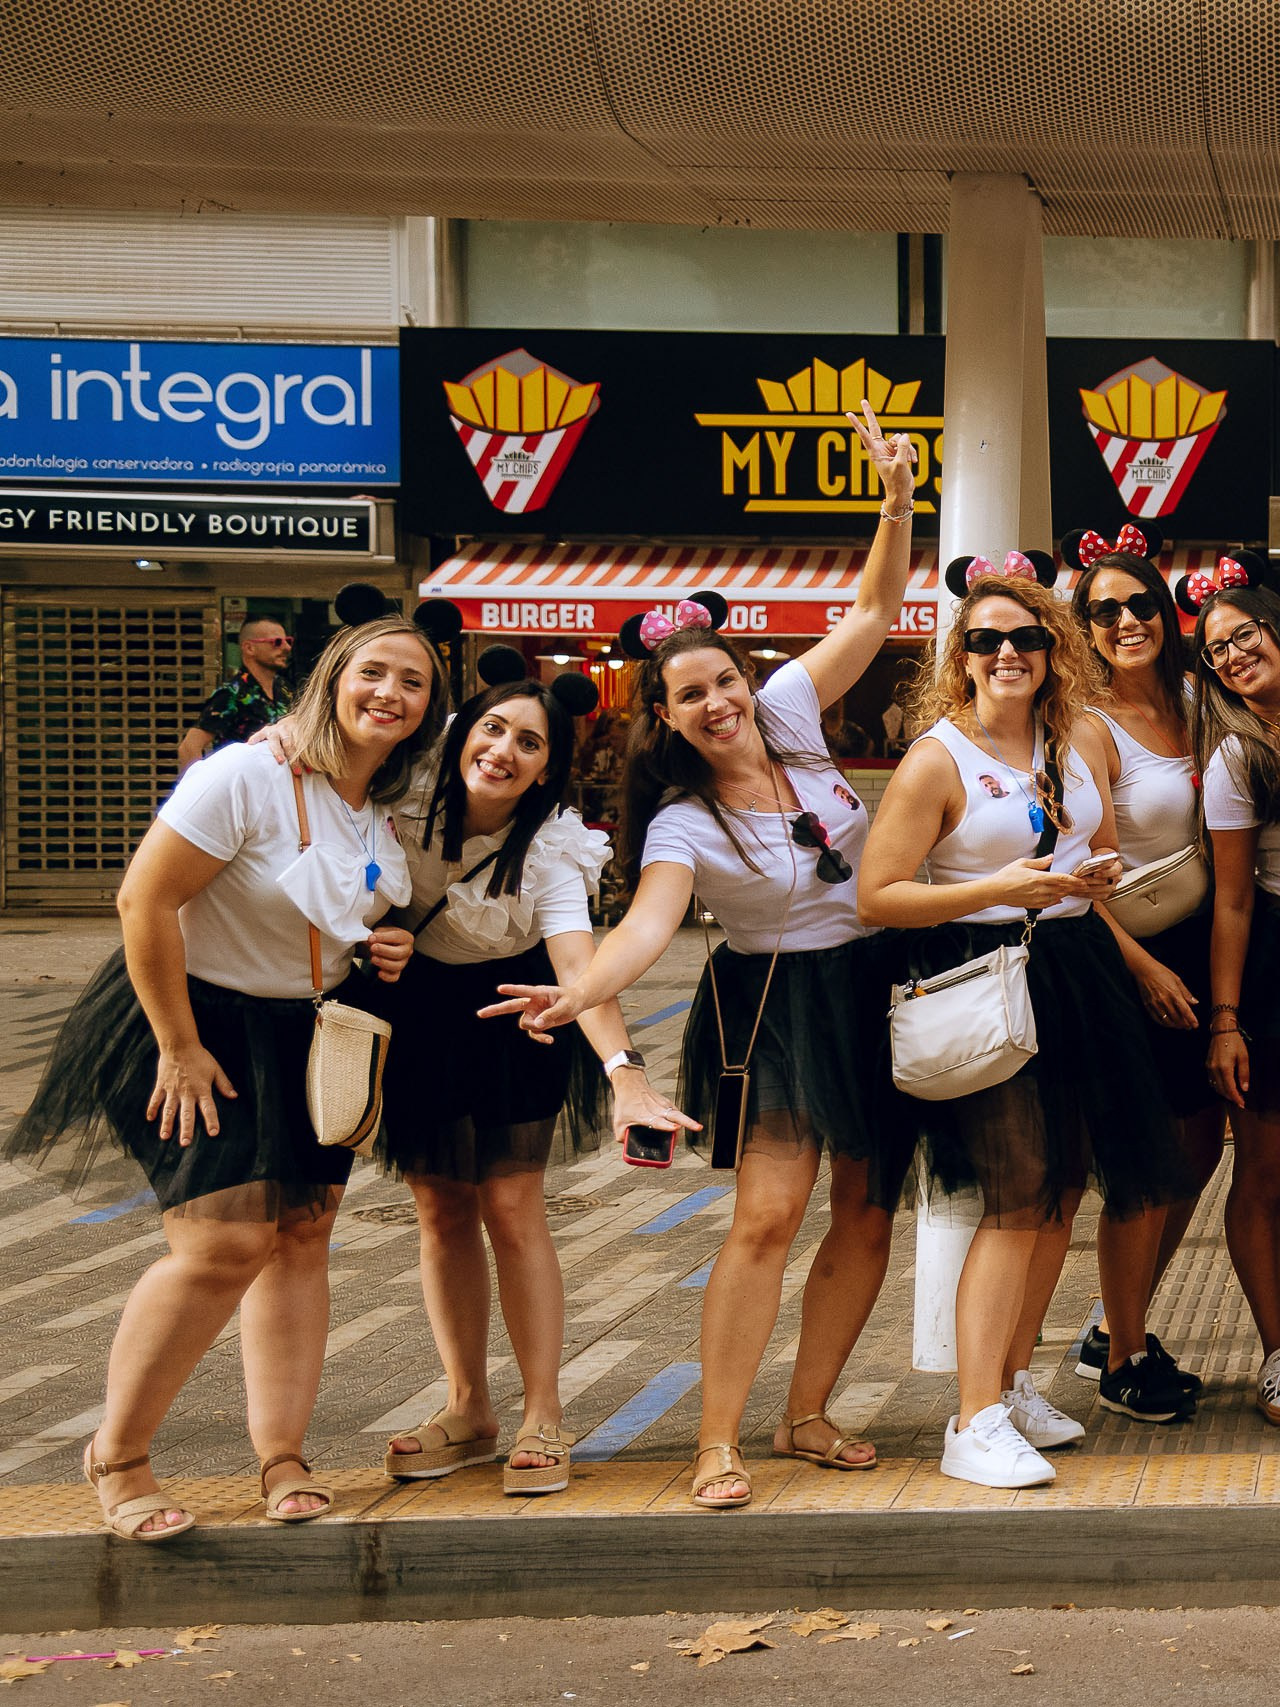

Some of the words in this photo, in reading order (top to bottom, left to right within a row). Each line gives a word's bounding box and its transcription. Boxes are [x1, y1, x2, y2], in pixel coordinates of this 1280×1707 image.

[51, 343, 373, 450] integral
[722, 431, 796, 495] MY
[49, 509, 196, 534] FRIENDLY
[208, 514, 359, 538] BOUTIQUE
[481, 603, 594, 629] BURGER
